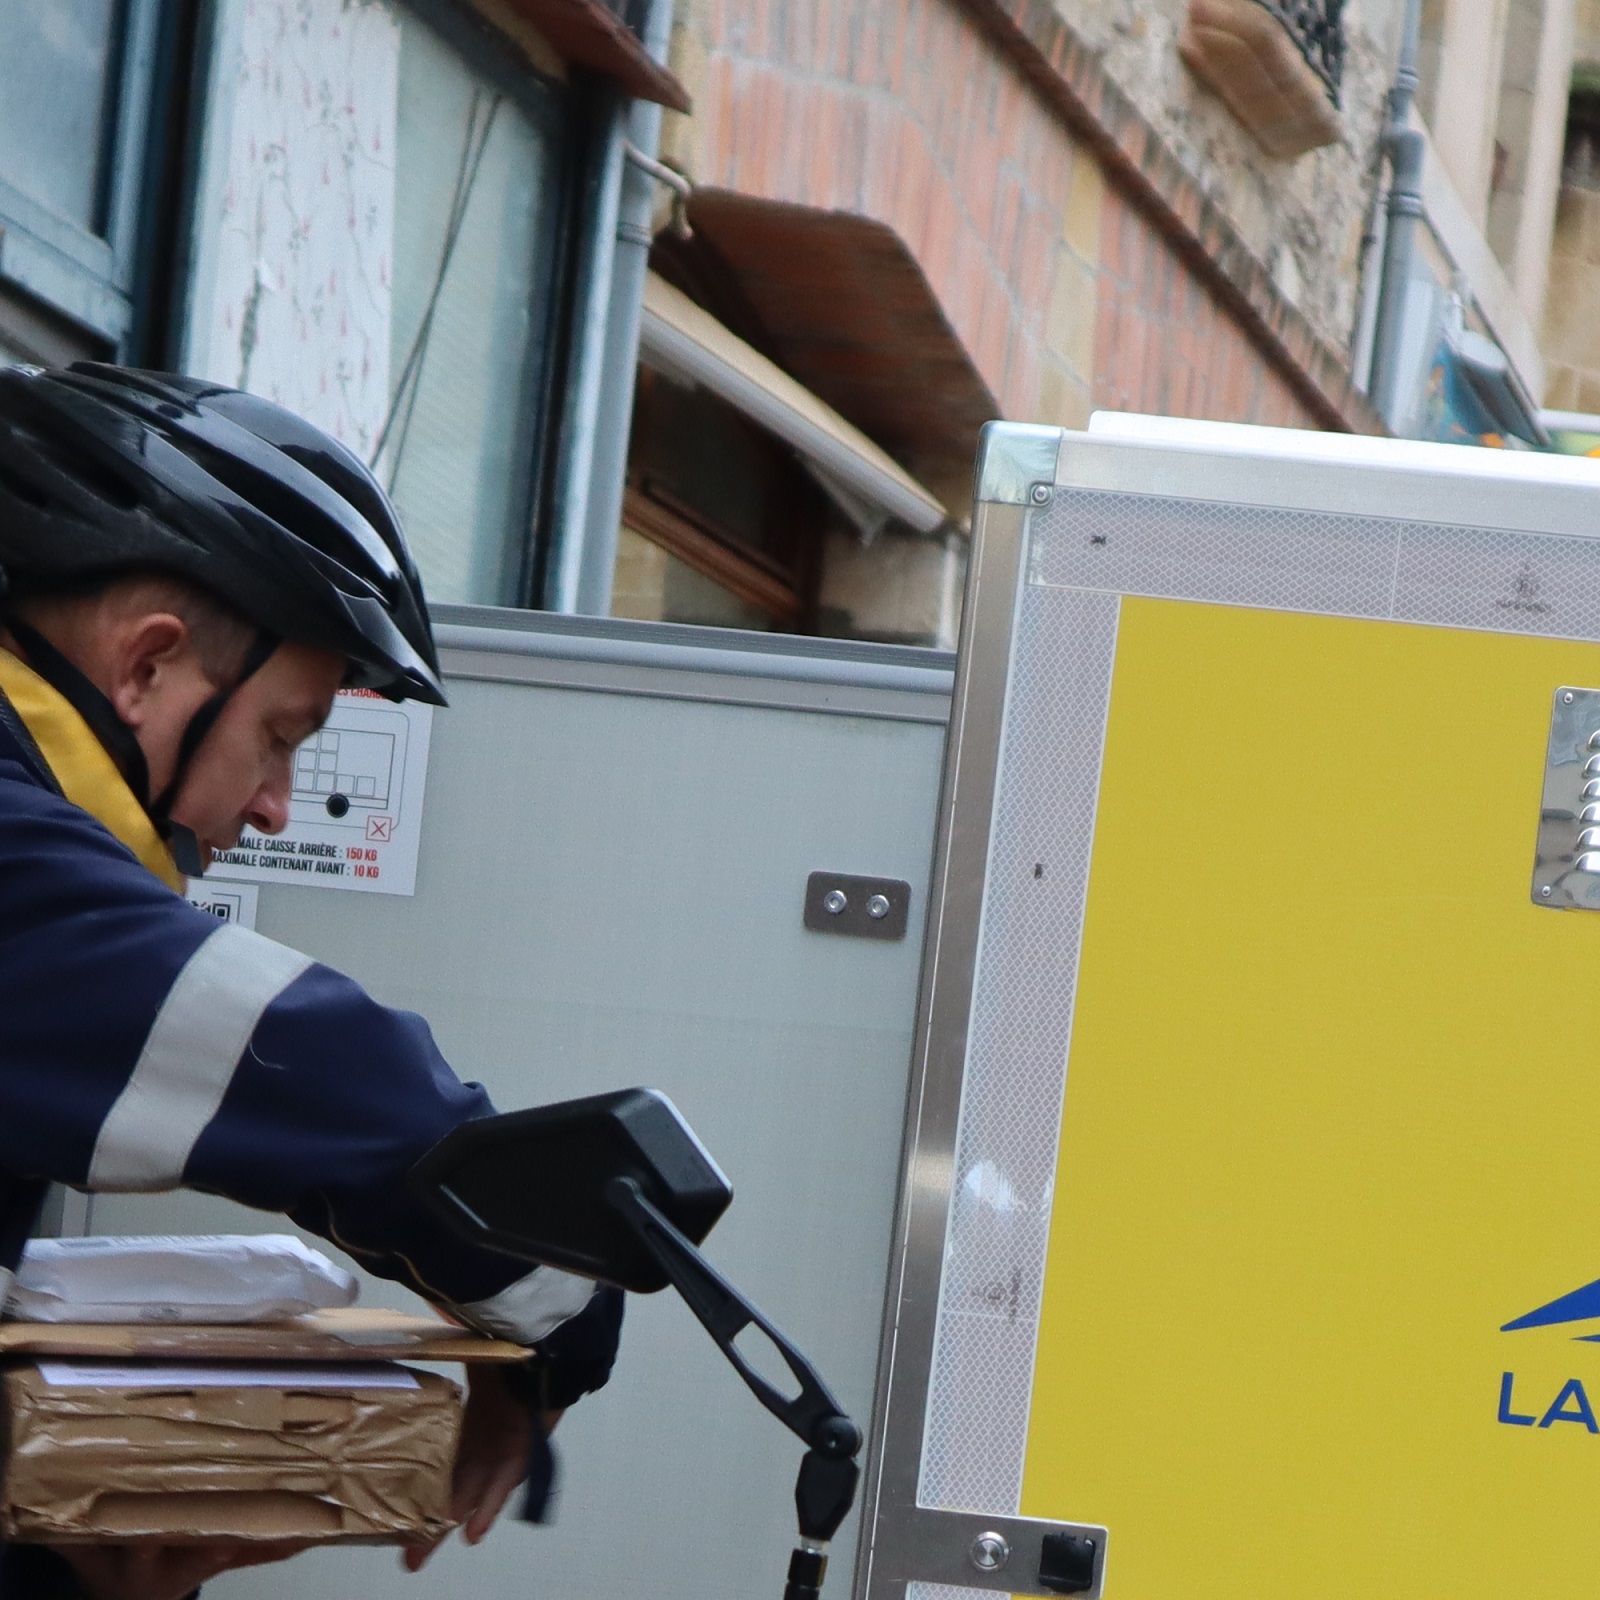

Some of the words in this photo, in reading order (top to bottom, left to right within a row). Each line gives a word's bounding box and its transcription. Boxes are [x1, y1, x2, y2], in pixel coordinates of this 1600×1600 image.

[264, 839, 297, 853] CAISSE
[298, 842, 338, 857] ARRIÈRE
[346, 847, 363, 860] 150
[364, 849, 378, 861] KG
[259, 855, 314, 873] CONTENANT
[315, 861, 346, 875] AVANT
[354, 865, 365, 877] 10
[366, 866, 380, 878] KG
[1498, 1371, 1600, 1434] LA
